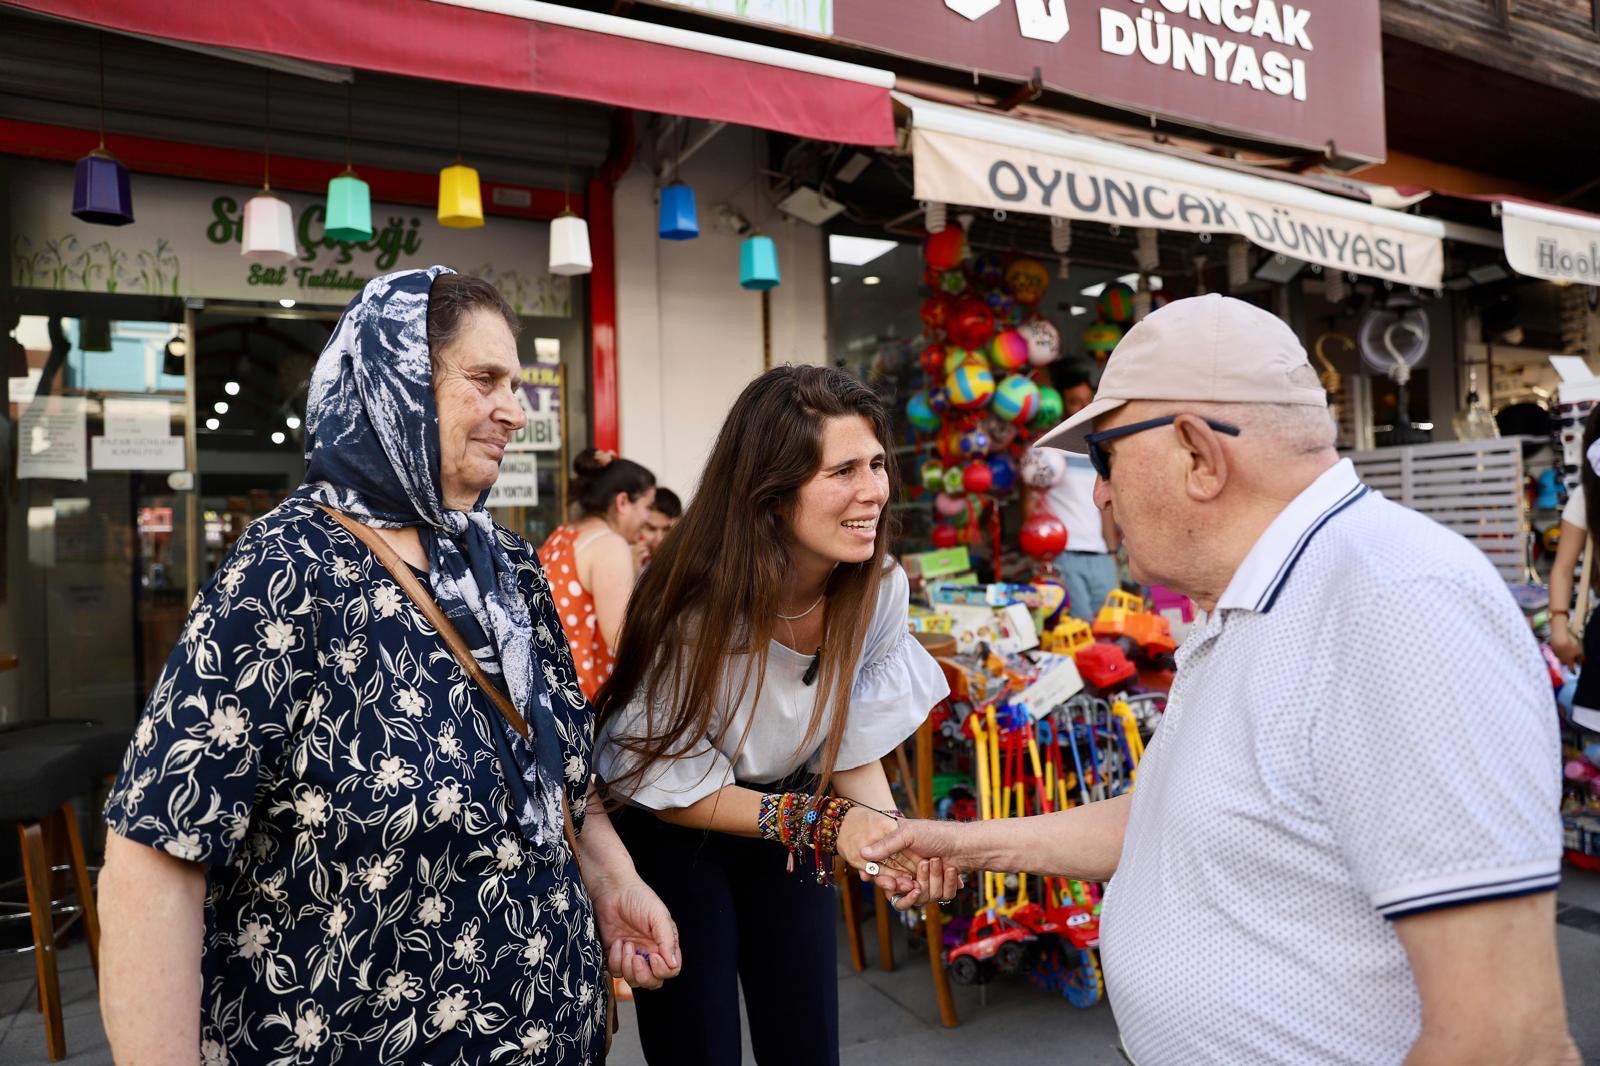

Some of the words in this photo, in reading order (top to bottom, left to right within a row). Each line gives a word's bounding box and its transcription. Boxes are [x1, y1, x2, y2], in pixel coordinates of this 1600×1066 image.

[1100, 7, 1307, 101] DÜNYASI
[988, 160, 1238, 228] OYUNCAK
[1246, 208, 1407, 274] DÜNYASI
[508, 418, 552, 443] DİBİ
